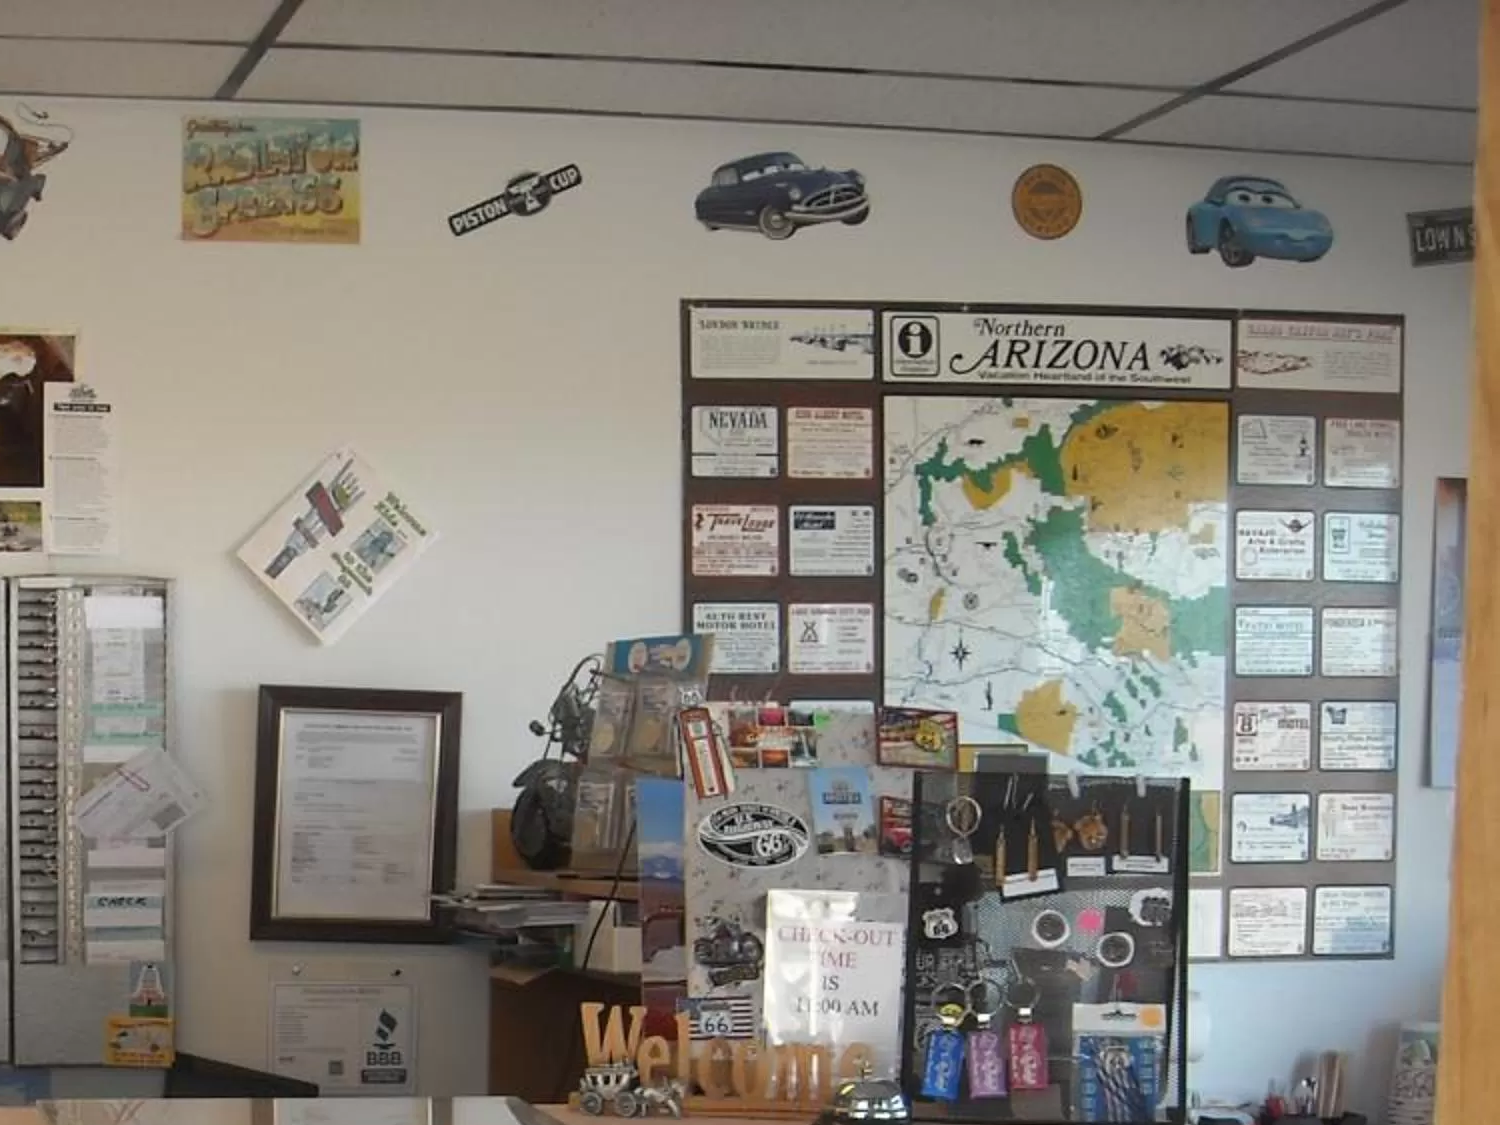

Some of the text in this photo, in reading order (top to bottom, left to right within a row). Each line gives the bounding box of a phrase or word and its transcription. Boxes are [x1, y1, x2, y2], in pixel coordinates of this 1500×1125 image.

[452, 168, 578, 233] PISTON CUP
[974, 318, 1065, 337] Northern
[950, 341, 1151, 374] ARIZONA
[709, 411, 768, 429] NEVADA
[757, 831, 784, 857] 66
[812, 952, 858, 970] IME
[821, 975, 841, 991] IS
[844, 999, 880, 1017] AM
[703, 1014, 731, 1034] 66
[366, 1051, 403, 1067] BBB
[581, 1001, 876, 1100] Welcome
